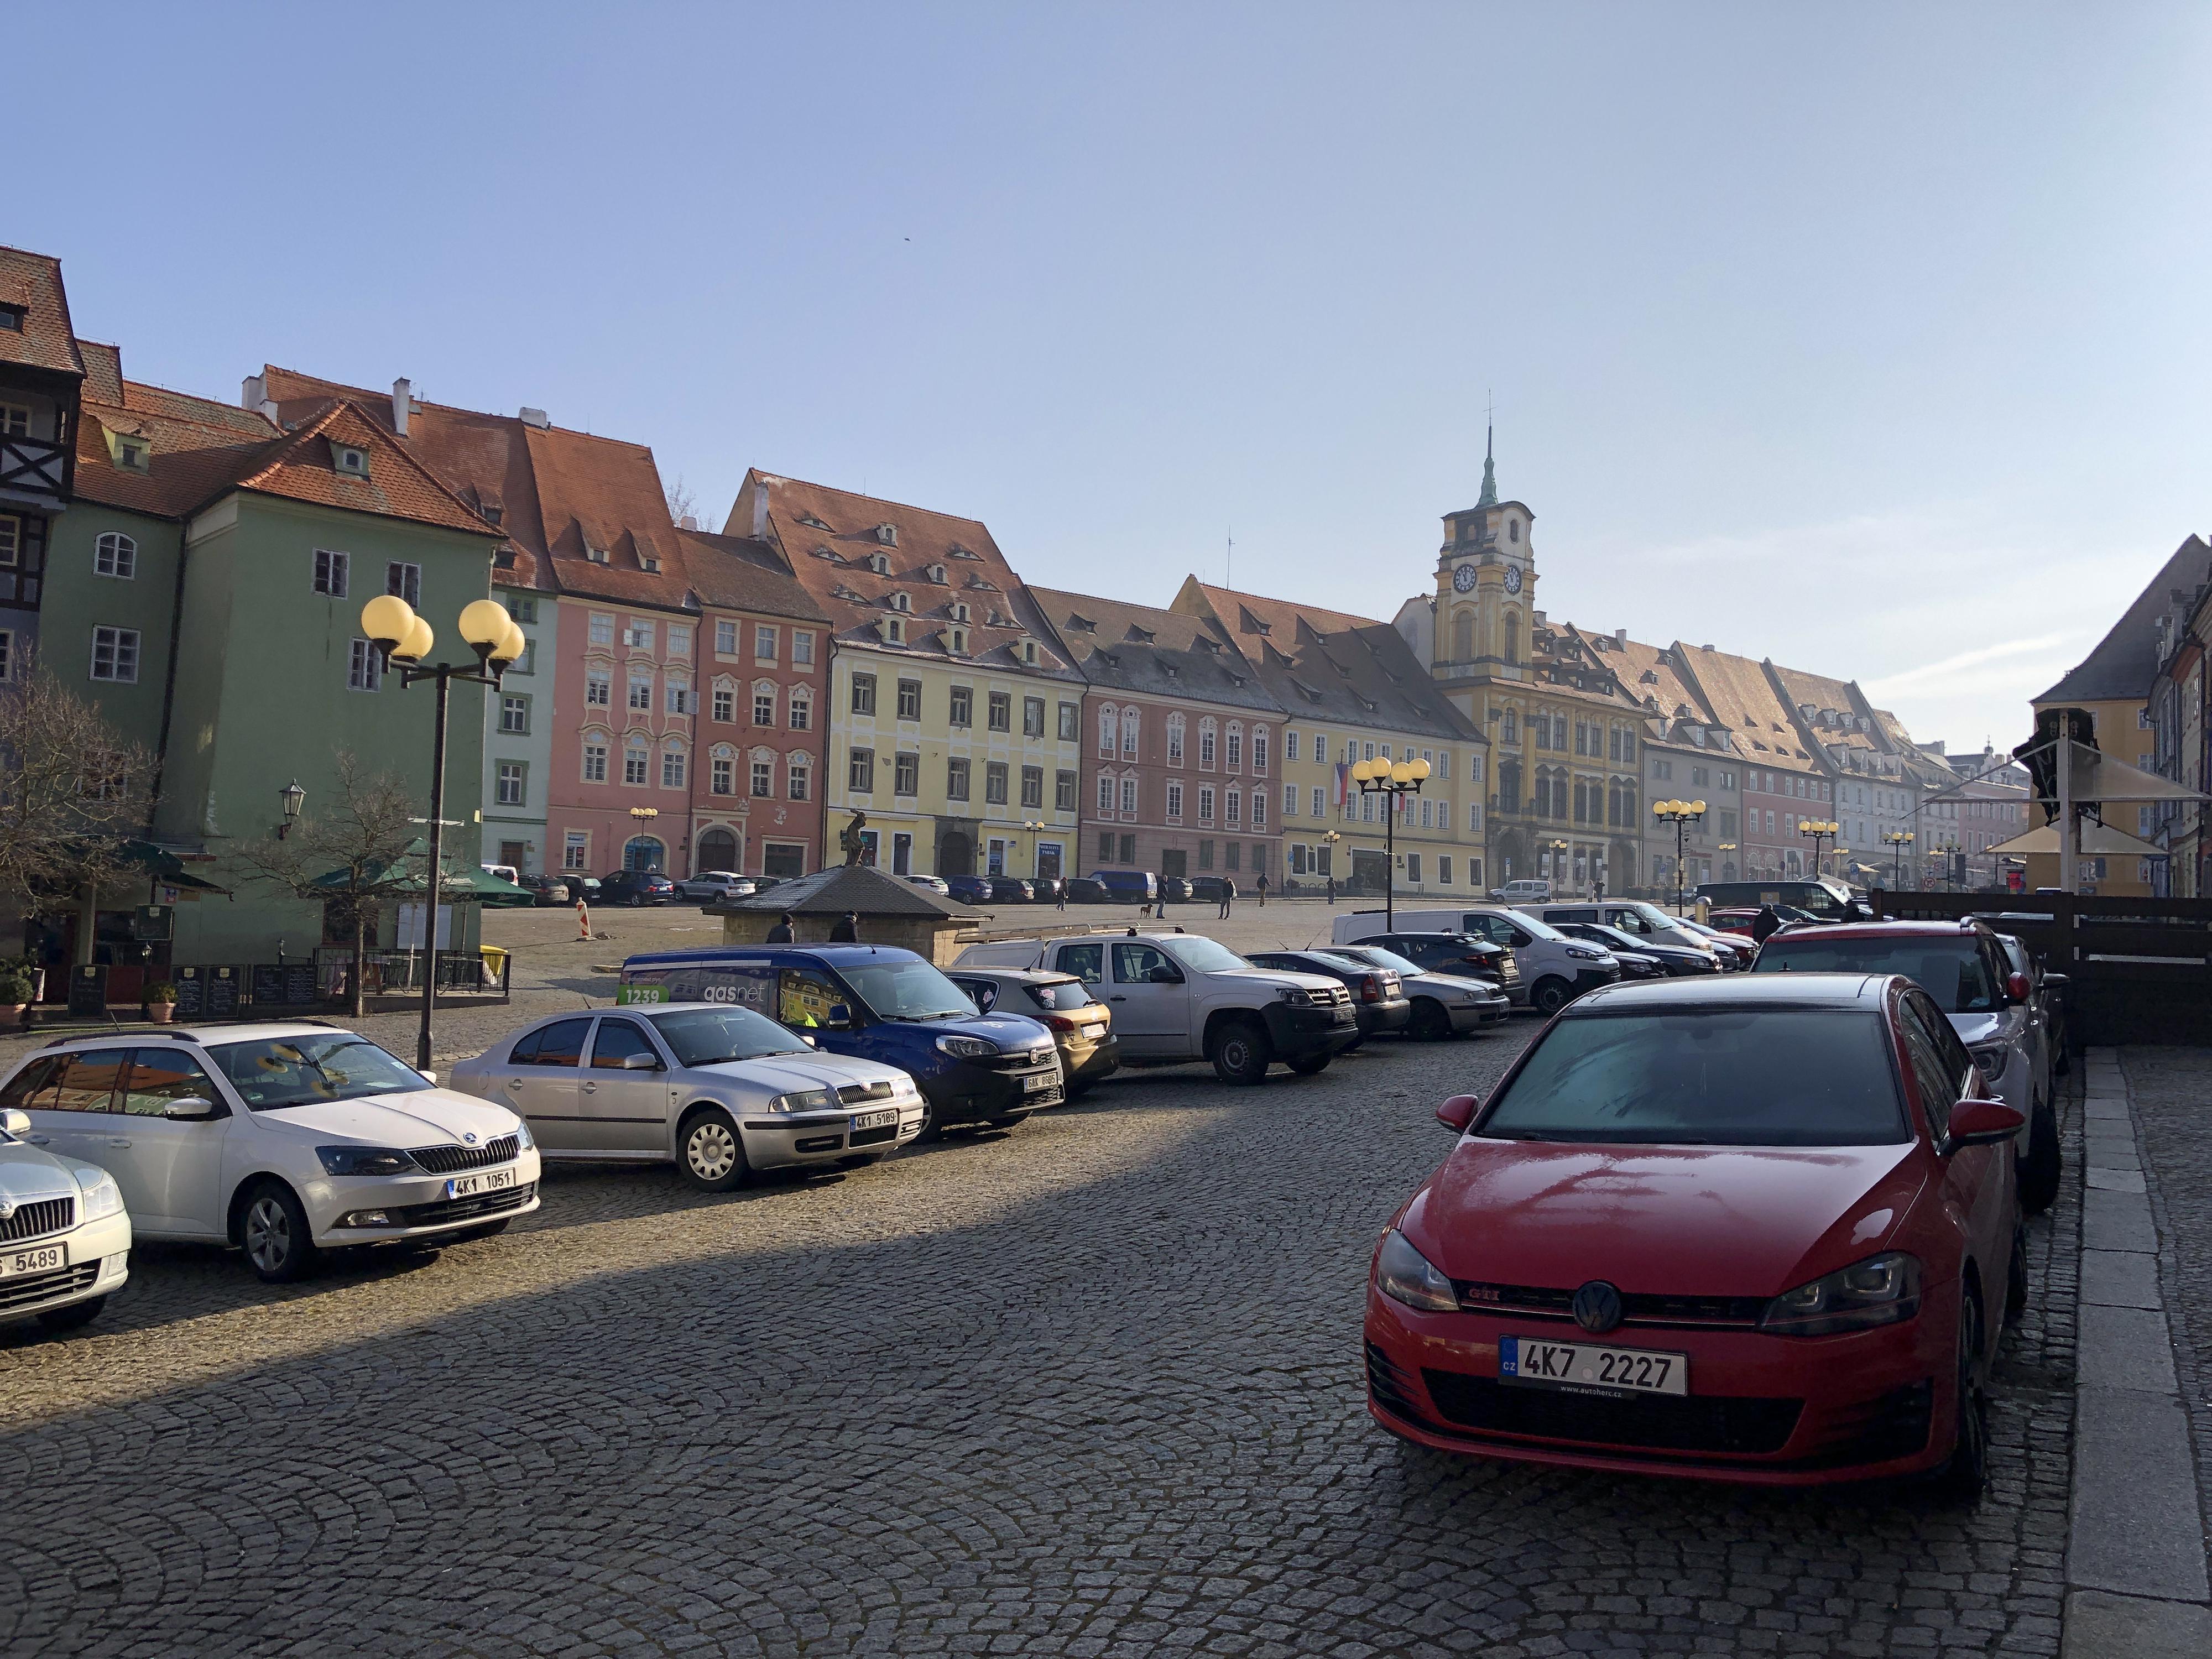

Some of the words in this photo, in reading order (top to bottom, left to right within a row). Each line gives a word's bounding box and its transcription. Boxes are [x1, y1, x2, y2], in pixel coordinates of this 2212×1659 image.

[626, 989, 660, 1003] 1239
[704, 984, 765, 1003] gasnet
[857, 1115, 871, 1128] 4K1
[877, 1112, 895, 1125] 5189
[456, 1178, 477, 1194] 4K1
[486, 1172, 510, 1189] 1051
[16, 1249, 57, 1272] 5489
[1469, 1288, 1500, 1301] GTI
[1503, 1361, 1516, 1371] CZ
[1525, 1344, 1575, 1378] 4K7
[1599, 1352, 1671, 1388] 2227
